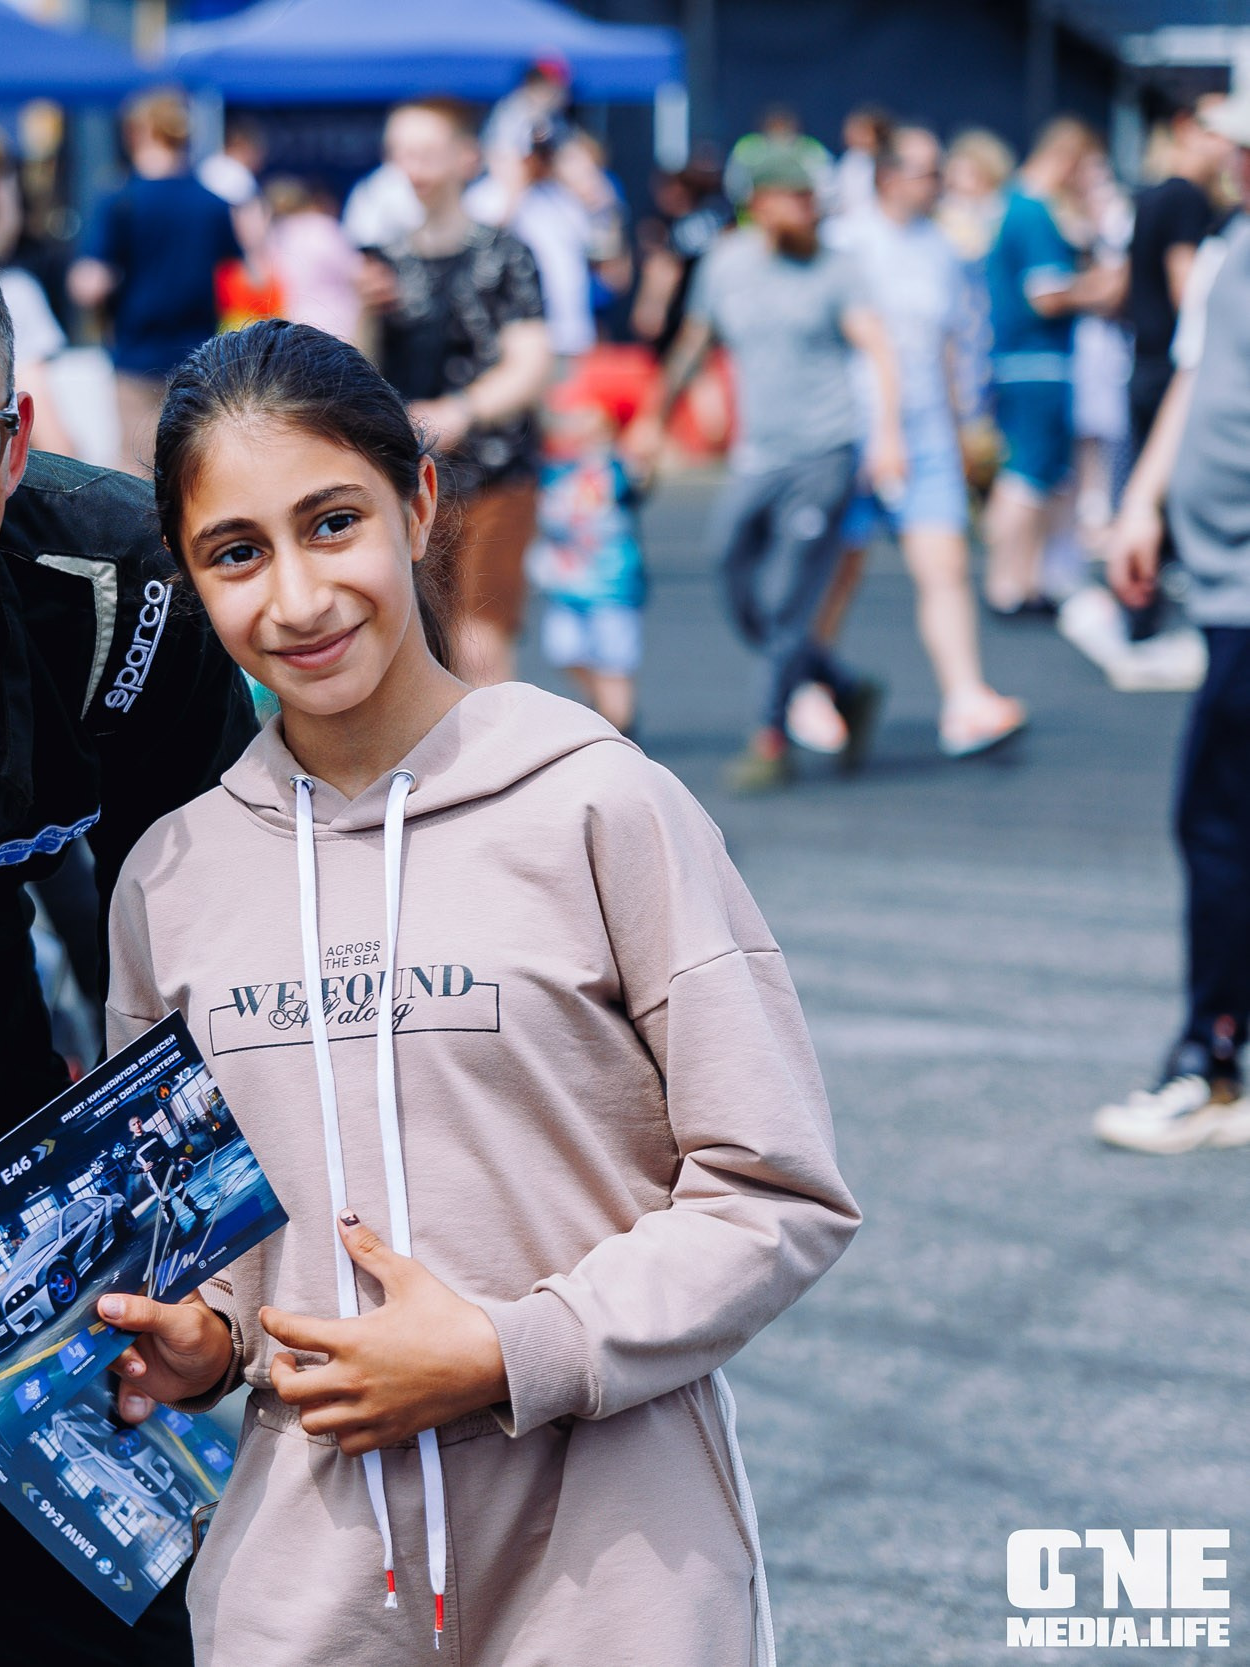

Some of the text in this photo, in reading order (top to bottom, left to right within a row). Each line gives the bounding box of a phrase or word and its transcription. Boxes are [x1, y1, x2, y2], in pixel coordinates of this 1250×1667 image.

[105, 580, 171, 712] sparco
[324, 953, 379, 969] THE SEA
[325, 941, 381, 957] ACROSS
[229, 981, 303, 1018] WE
[338, 992, 414, 1031] alog
[118, 1050, 181, 1100] DRIFTHUNTERS
[0, 1155, 32, 1185] E46
[38, 1499, 98, 1559] BMW E46
